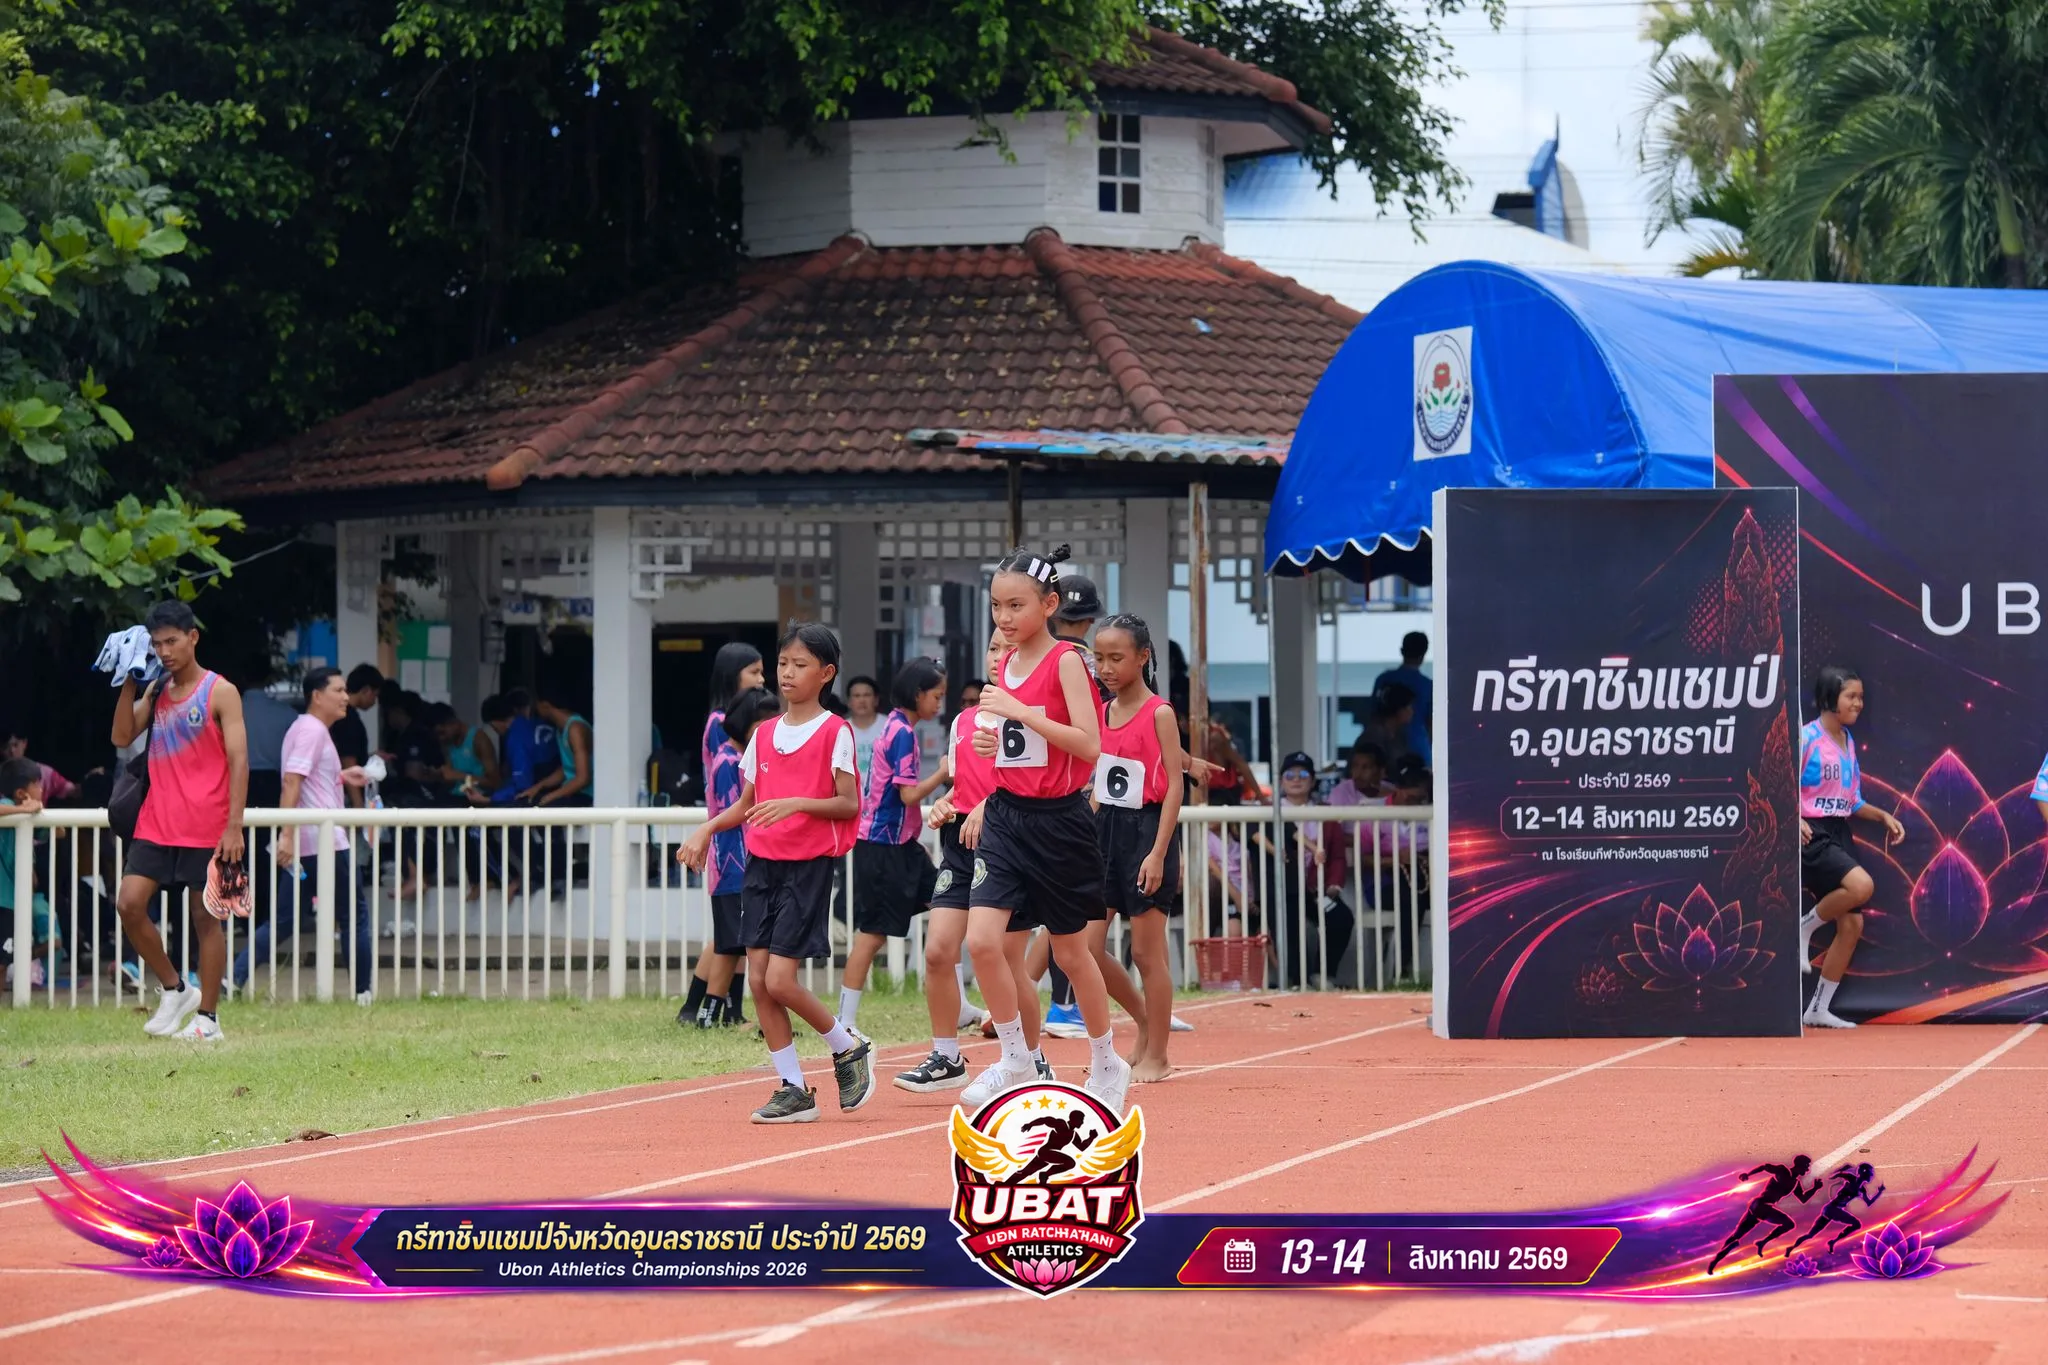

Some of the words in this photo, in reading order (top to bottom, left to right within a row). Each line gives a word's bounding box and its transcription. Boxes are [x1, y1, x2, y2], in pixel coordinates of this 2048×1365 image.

[1473, 654, 1781, 711] กรีฑาชิงแชมป์
[1002, 718, 1026, 758] 6
[1510, 715, 1736, 767] จ.อุบลราชธานี
[1106, 765, 1129, 798] 6
[1578, 772, 1630, 789] ประจำปี
[1634, 773, 1671, 788] 2569
[1512, 806, 1585, 830] 12-14
[1592, 805, 1676, 829] สิงหาคม
[1683, 805, 1740, 828] 2569
[1541, 850, 1553, 861] ณ
[1556, 845, 1709, 863] โรงเรียนกีฬาจังหวัดอุบลราชธานี
